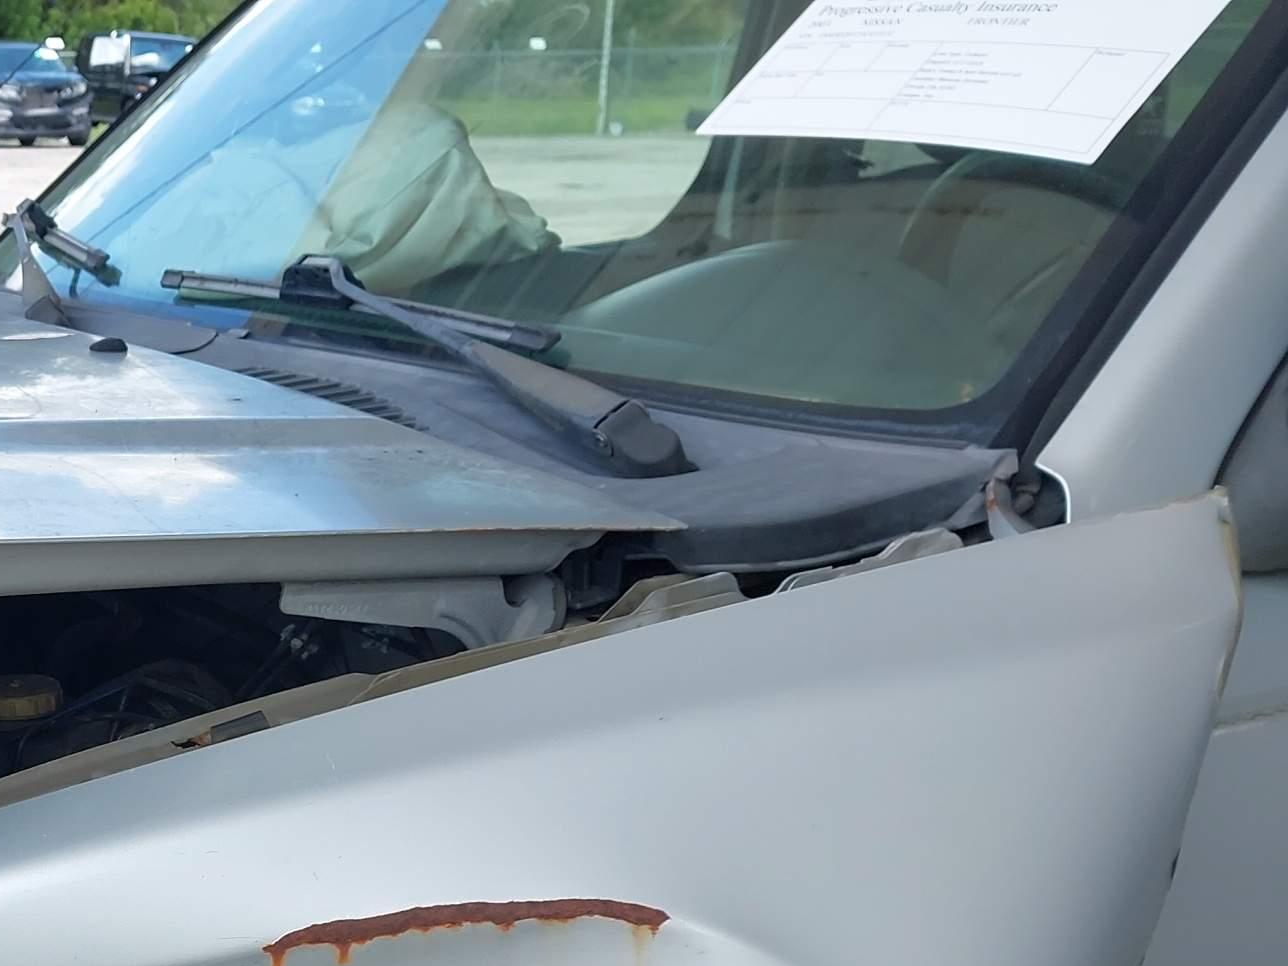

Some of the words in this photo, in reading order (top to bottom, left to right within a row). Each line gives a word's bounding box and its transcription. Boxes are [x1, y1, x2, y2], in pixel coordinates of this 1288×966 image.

[818, 4, 903, 17] Progressive
[905, 1, 968, 15] Casualty
[976, 0, 1058, 12] Insurance
